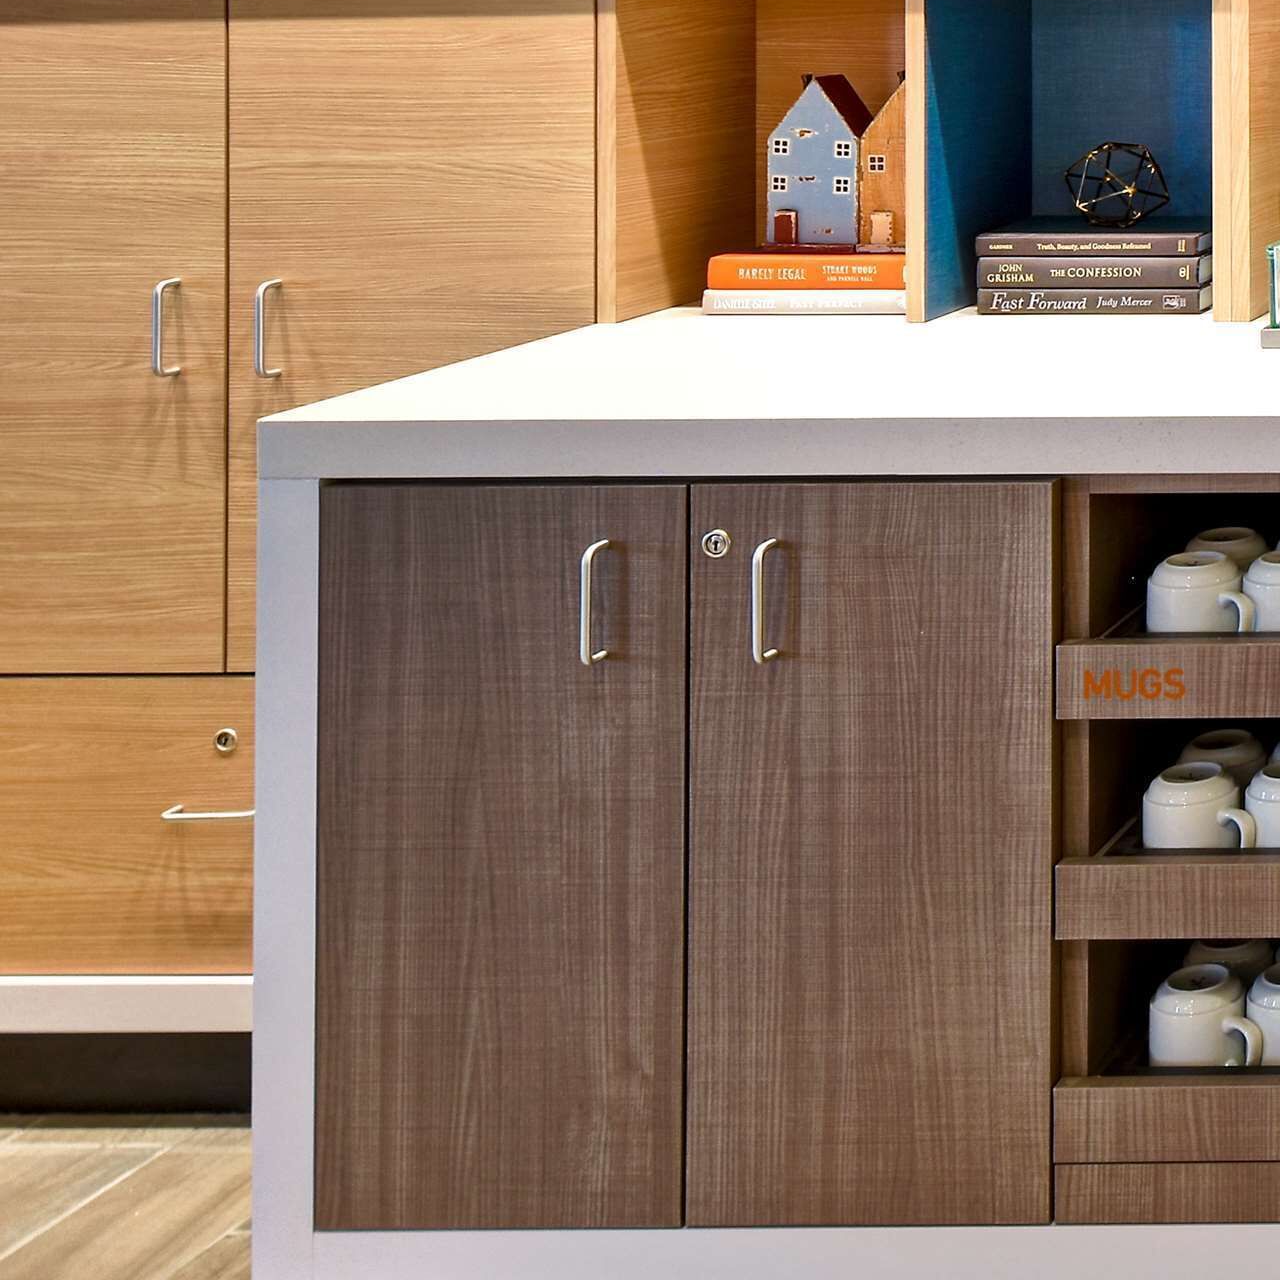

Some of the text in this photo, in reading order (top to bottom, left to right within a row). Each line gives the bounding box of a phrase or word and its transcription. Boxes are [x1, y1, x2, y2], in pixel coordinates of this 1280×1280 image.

[738, 268, 806, 280] BARELY LEGAL
[987, 267, 1142, 283] GRISHAM THE CONFESSION
[999, 264, 1023, 273] JOHN
[990, 292, 1024, 311] Fast
[1026, 292, 1087, 310] Forward
[1096, 296, 1118, 308] Judy
[1120, 296, 1153, 307] Mercer
[1083, 668, 1186, 700] MUGS
